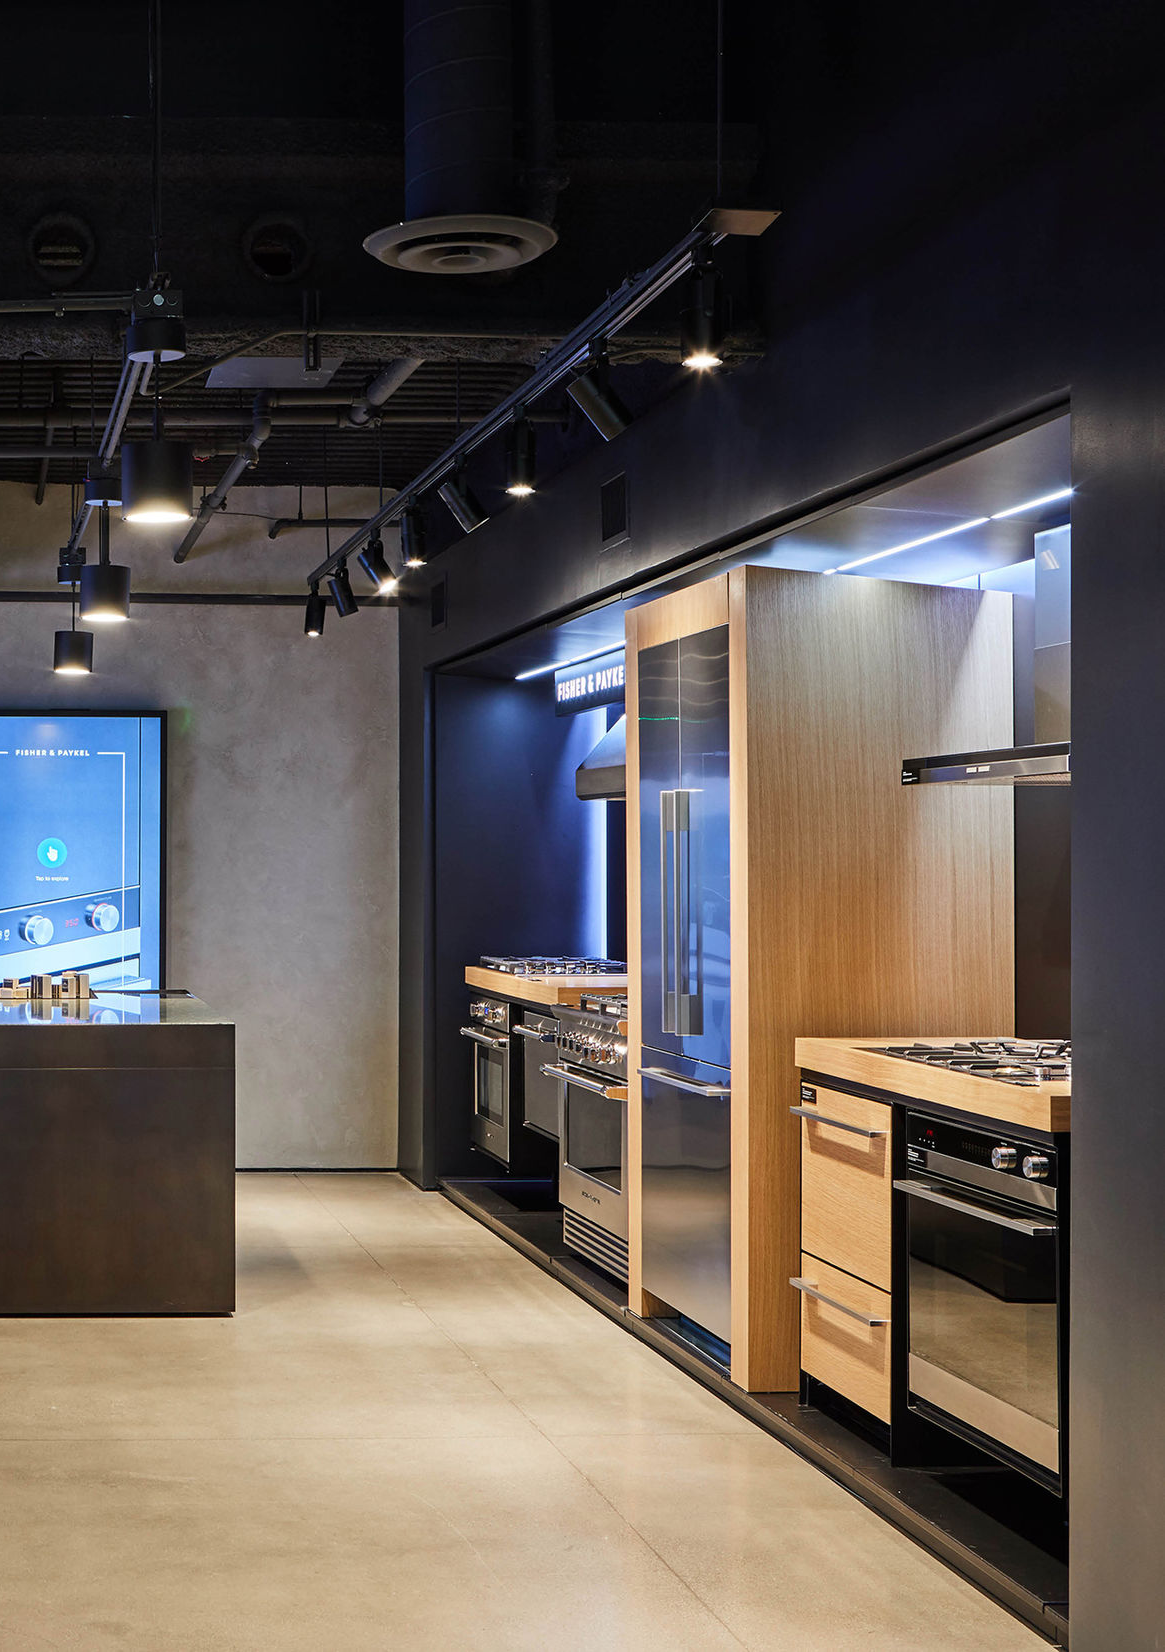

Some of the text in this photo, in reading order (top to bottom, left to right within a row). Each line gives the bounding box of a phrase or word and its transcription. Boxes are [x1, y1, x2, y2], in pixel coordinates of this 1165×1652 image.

[557, 665, 625, 702] FISHER & PAYKE
